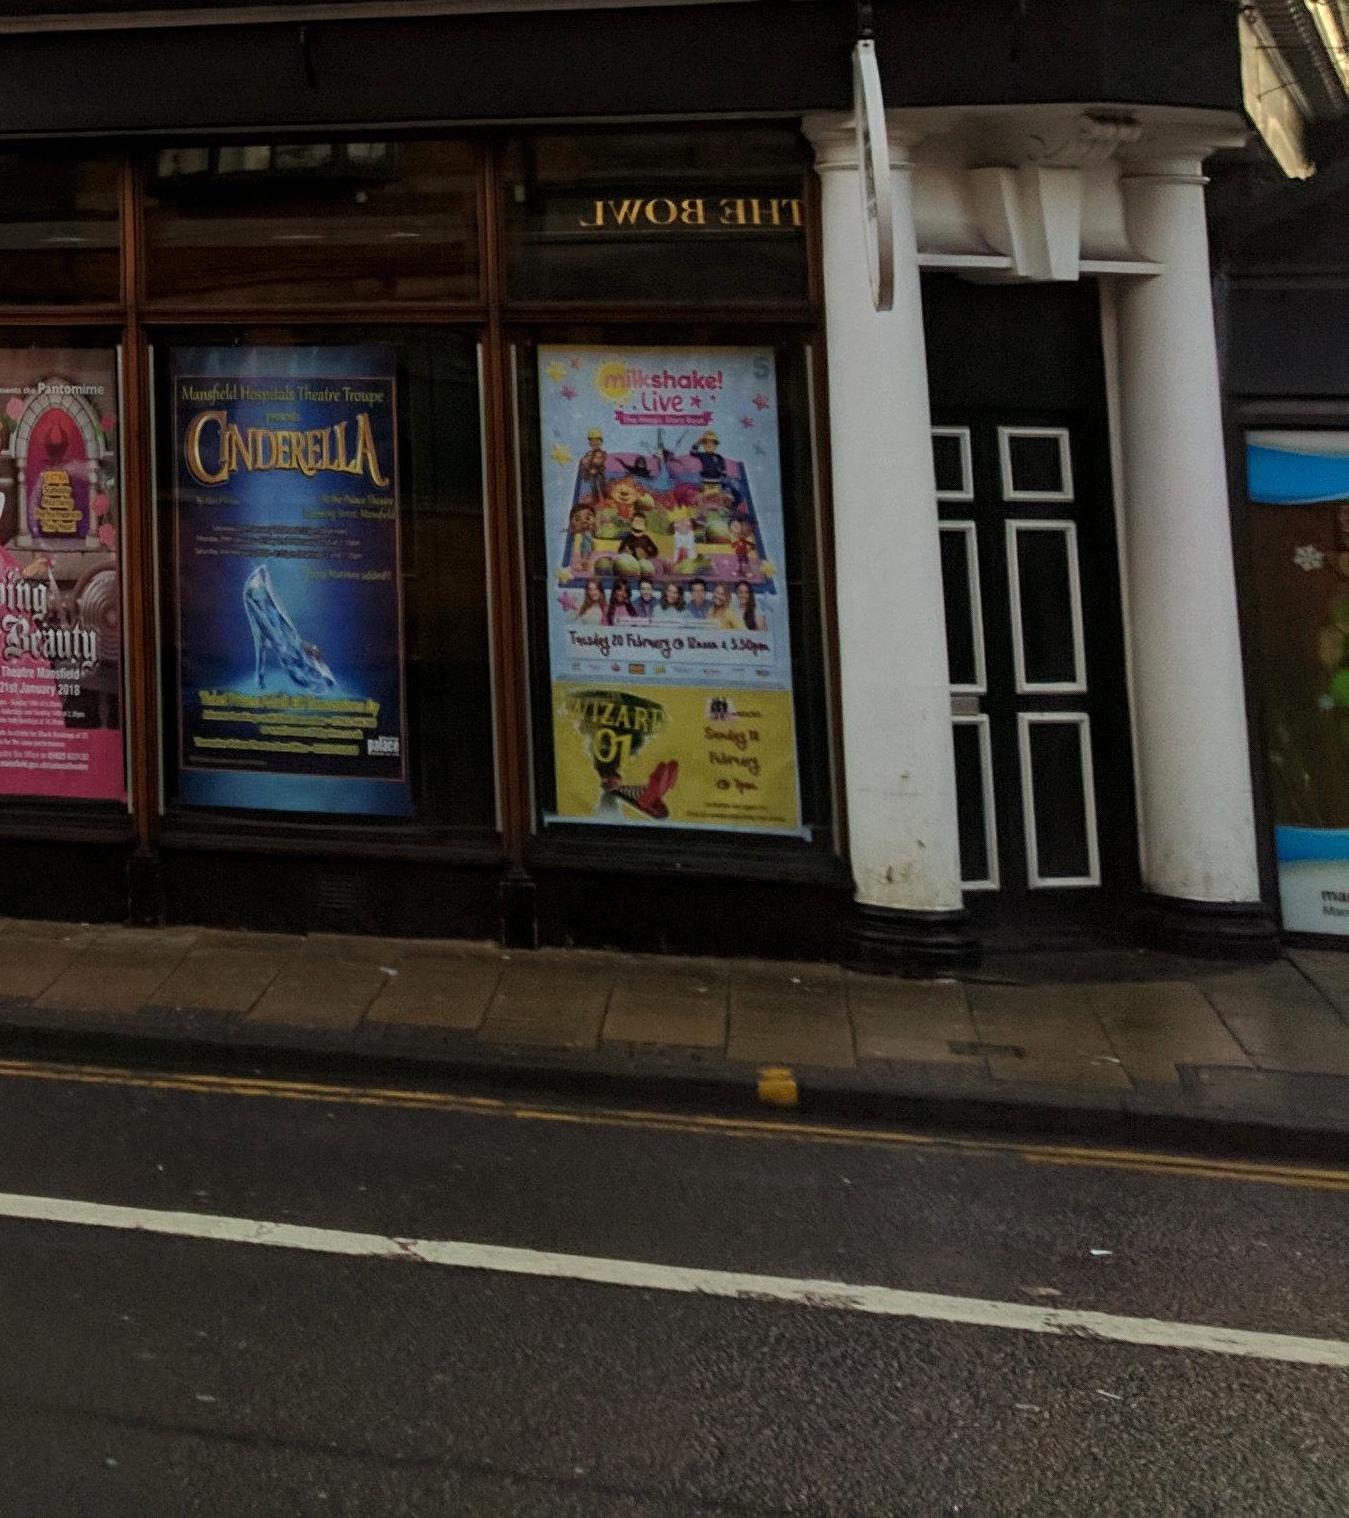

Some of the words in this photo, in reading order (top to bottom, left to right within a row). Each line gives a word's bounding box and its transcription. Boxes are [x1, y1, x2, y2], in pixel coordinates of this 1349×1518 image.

[37, 382, 105, 396] Pantomime
[603, 369, 723, 390] milkshake!
[181, 383, 237, 405] Mansfield
[297, 385, 340, 402] Theatre
[342, 386, 385, 407] Troupe
[184, 409, 390, 489] CINDERELLA
[0, 614, 100, 671] Beauty
[625, 633, 671, 659] February
[0, 666, 35, 679] Theatre
[36, 667, 80, 680] Mansfield
[19, 683, 56, 697] January
[57, 684, 81, 696] 2018
